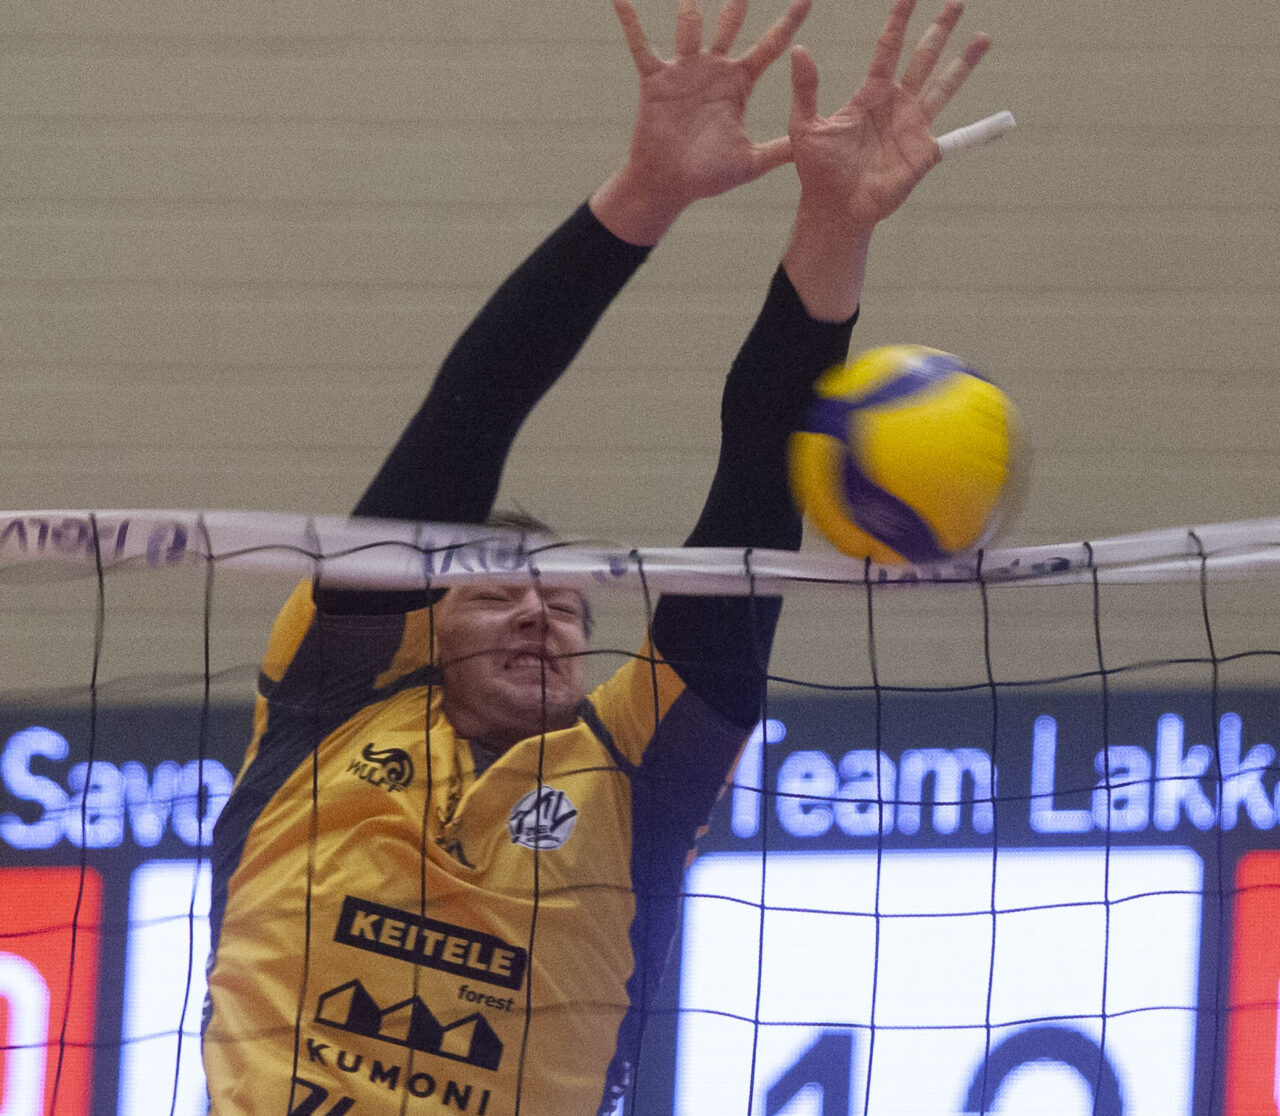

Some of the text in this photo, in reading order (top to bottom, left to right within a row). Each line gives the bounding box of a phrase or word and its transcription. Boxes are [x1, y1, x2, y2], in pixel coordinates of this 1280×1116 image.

[731, 718, 998, 838] Team
[350, 909, 516, 978] KEITELE
[457, 984, 515, 1012] forest
[305, 1037, 491, 1116] KUMONI
